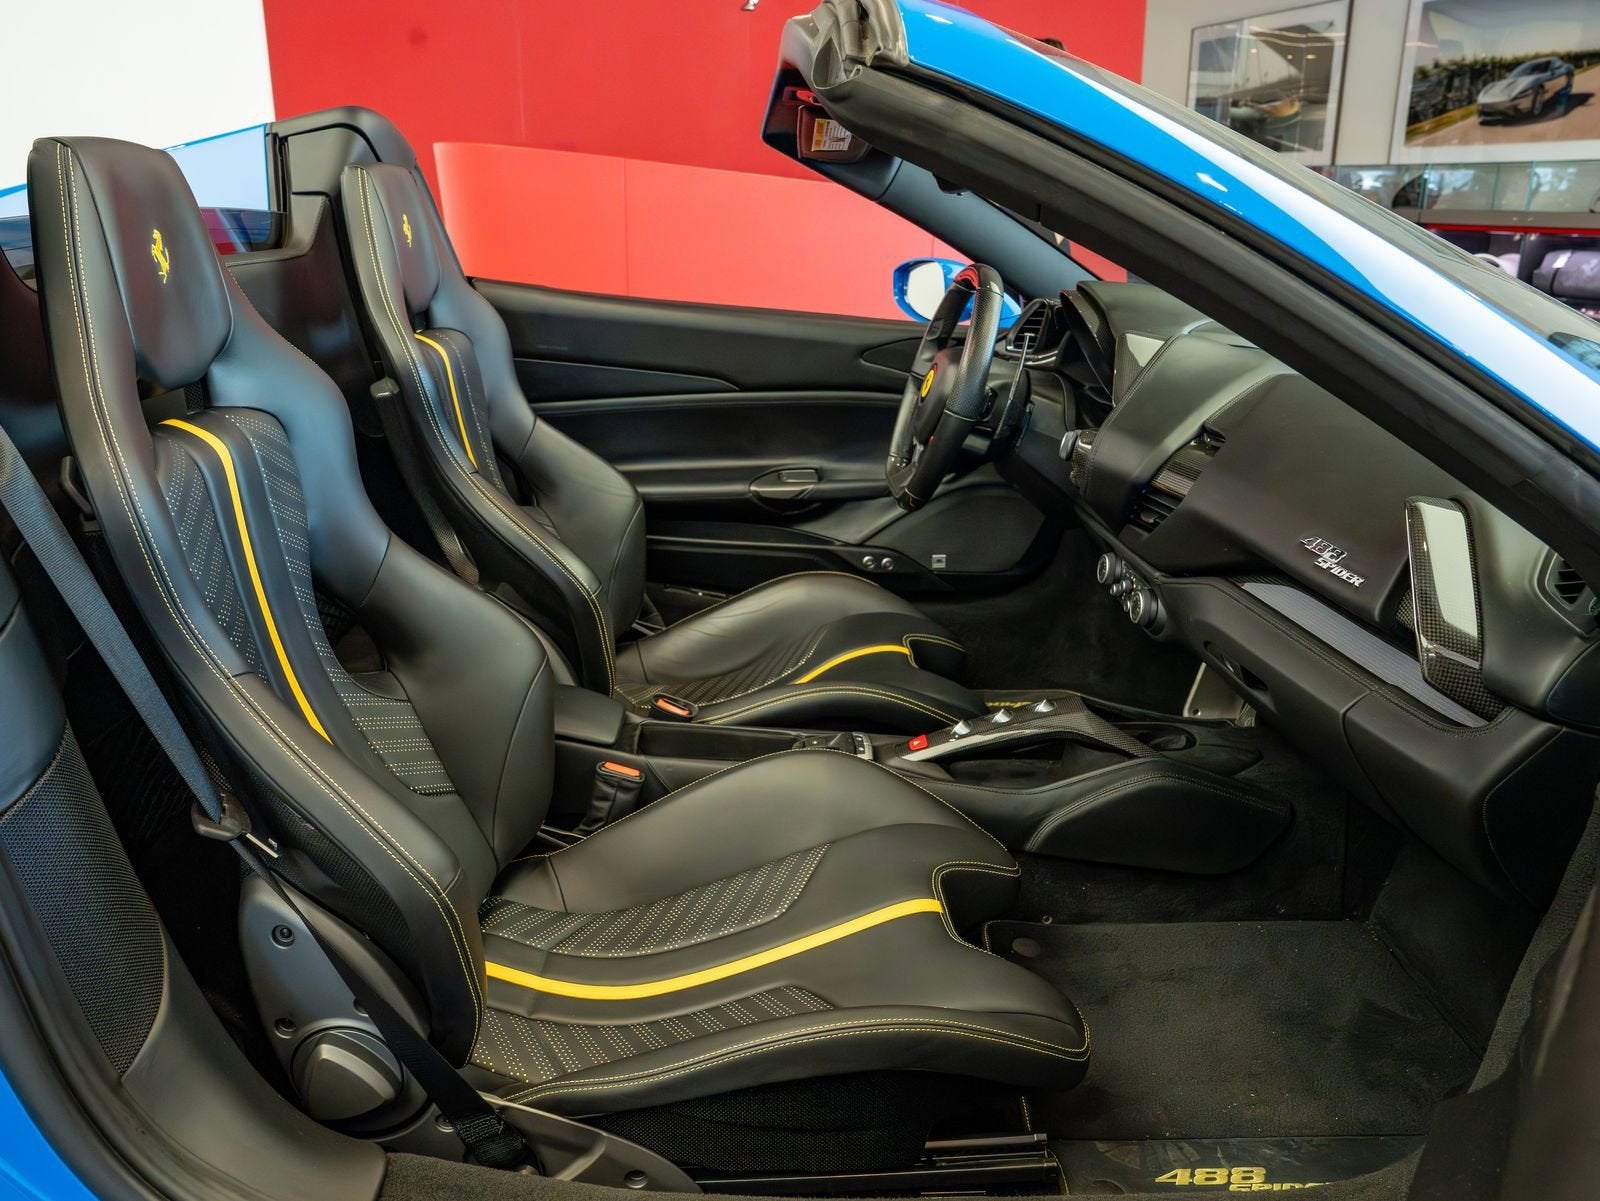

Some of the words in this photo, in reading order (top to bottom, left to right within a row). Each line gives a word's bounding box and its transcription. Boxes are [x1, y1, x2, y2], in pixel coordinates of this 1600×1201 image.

[1299, 536, 1348, 564] 488
[1314, 557, 1365, 588] SPIDER
[1154, 1166, 1267, 1186] 488
